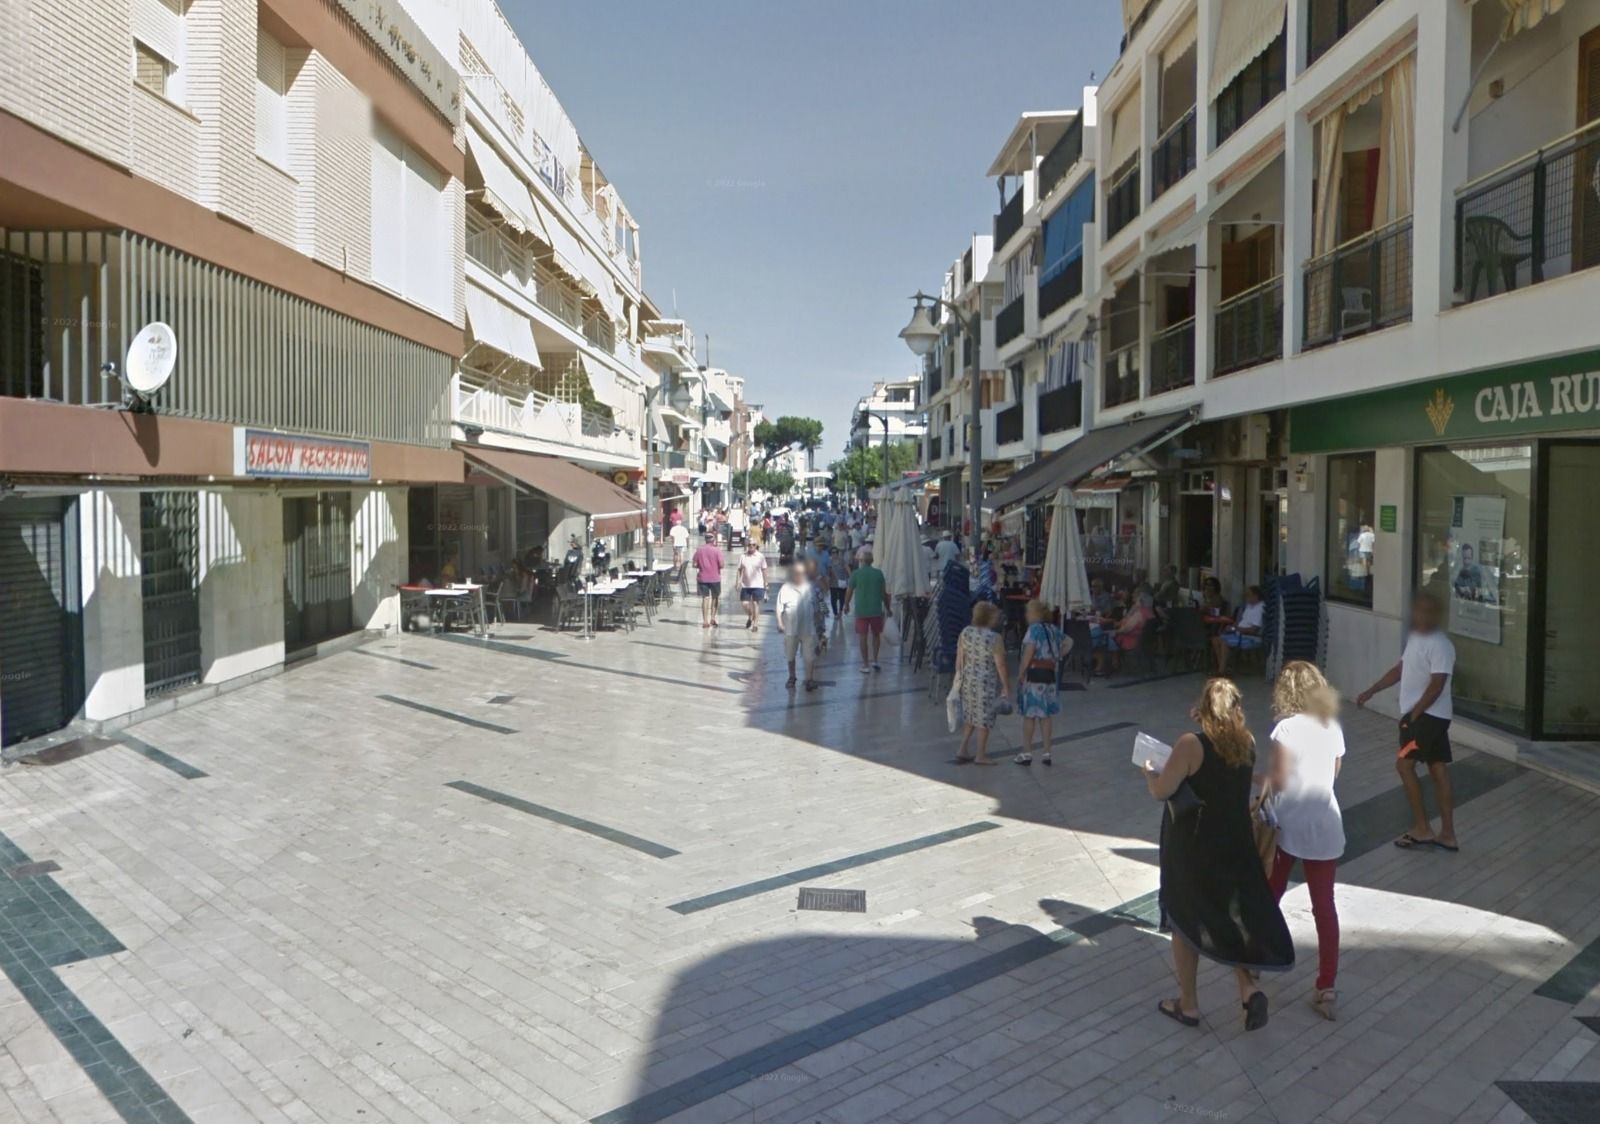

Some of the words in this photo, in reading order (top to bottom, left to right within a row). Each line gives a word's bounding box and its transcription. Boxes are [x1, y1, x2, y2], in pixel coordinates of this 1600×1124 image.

[1475, 381, 1543, 422] CAJA
[1550, 372, 1600, 415] RU
[249, 436, 296, 467] SALON
[300, 443, 369, 469] RECREATIVO
